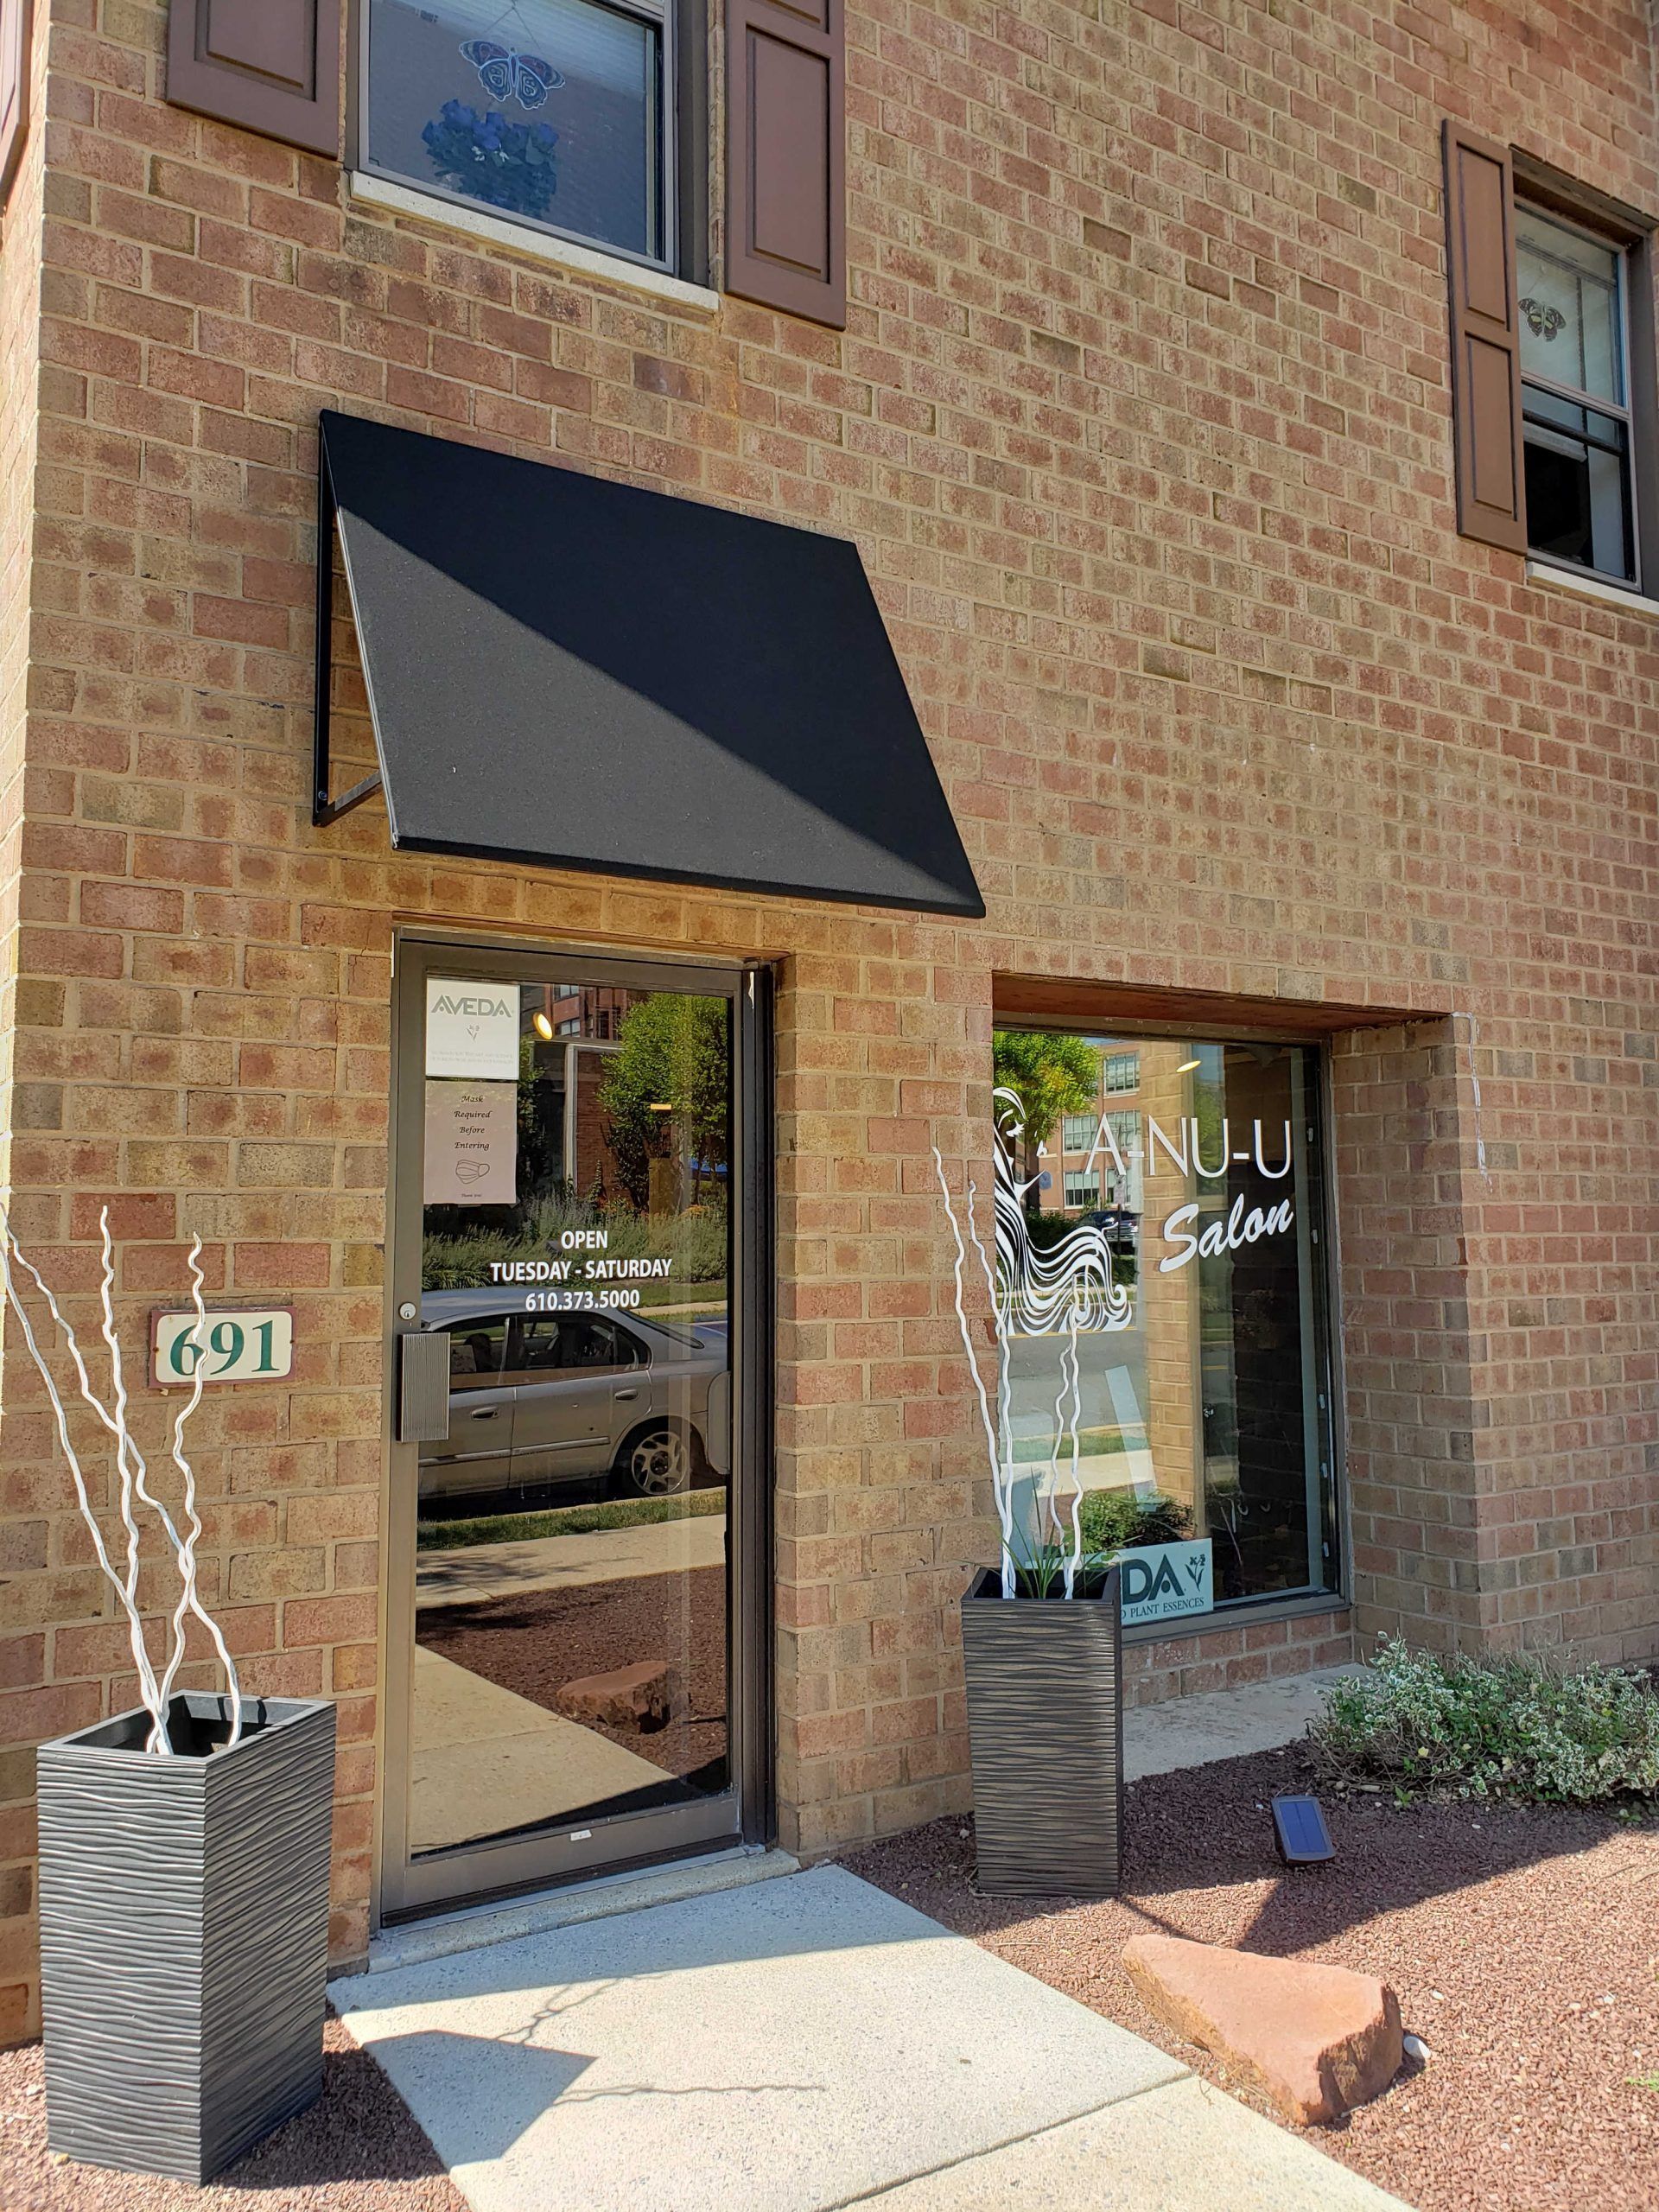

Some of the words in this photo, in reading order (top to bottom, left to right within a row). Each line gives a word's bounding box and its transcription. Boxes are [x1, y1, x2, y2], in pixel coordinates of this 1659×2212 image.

[431, 995, 512, 1018] AVEDA
[454, 1110, 493, 1120] Required
[459, 1125, 486, 1136] Before
[454, 1141, 490, 1151] Entering
[1084, 1114, 1290, 1179] A-NU-U
[561, 1230, 608, 1249] OPEN
[1159, 1192, 1294, 1273] Salon
[490, 1261, 572, 1282] TUESDAY
[585, 1258, 673, 1279] SATURDAY
[525, 1289, 640, 1312] 610.373.5000
[170, 1320, 280, 1376] 691
[1130, 1604, 1160, 1618] PLANT
[1163, 1597, 1205, 1612] ESSENCES
